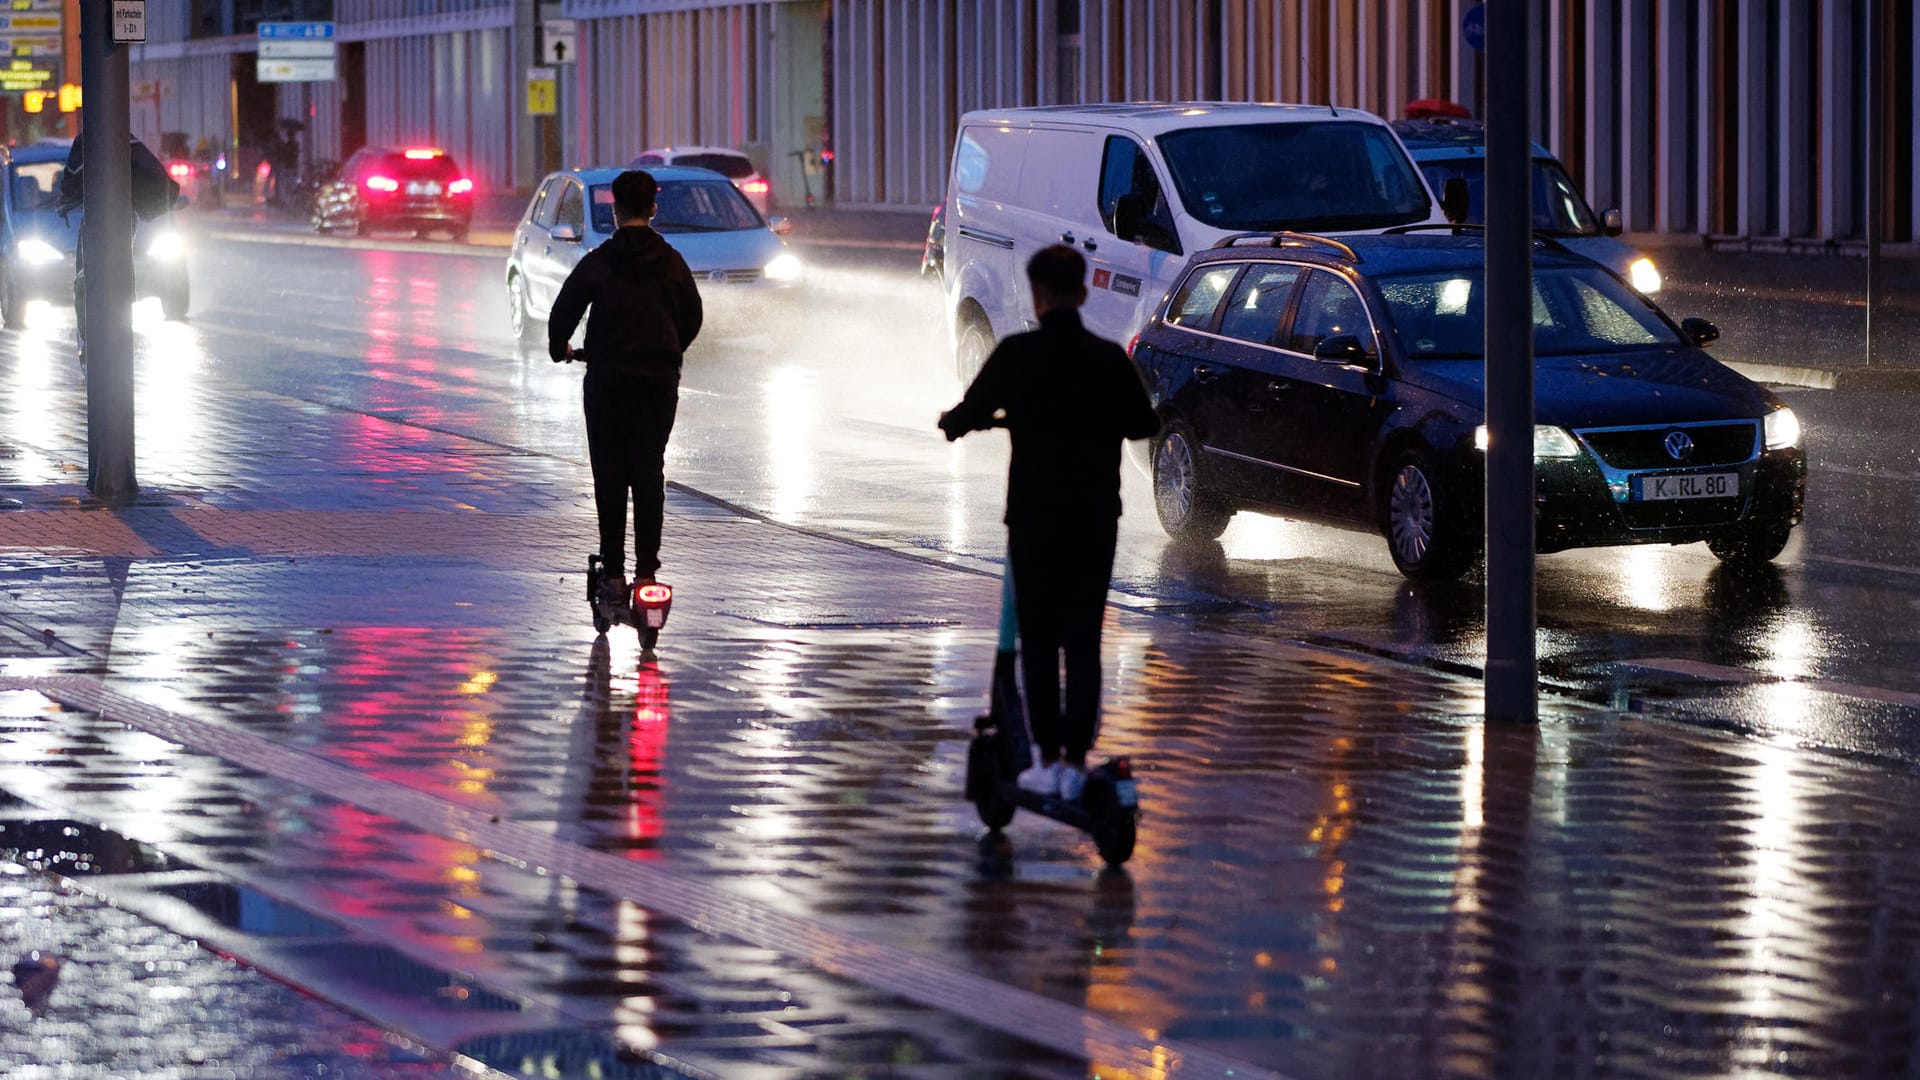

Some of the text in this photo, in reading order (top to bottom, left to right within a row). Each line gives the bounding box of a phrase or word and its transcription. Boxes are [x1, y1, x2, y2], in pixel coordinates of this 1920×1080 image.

[1655, 476, 1726, 497] K RL 80
